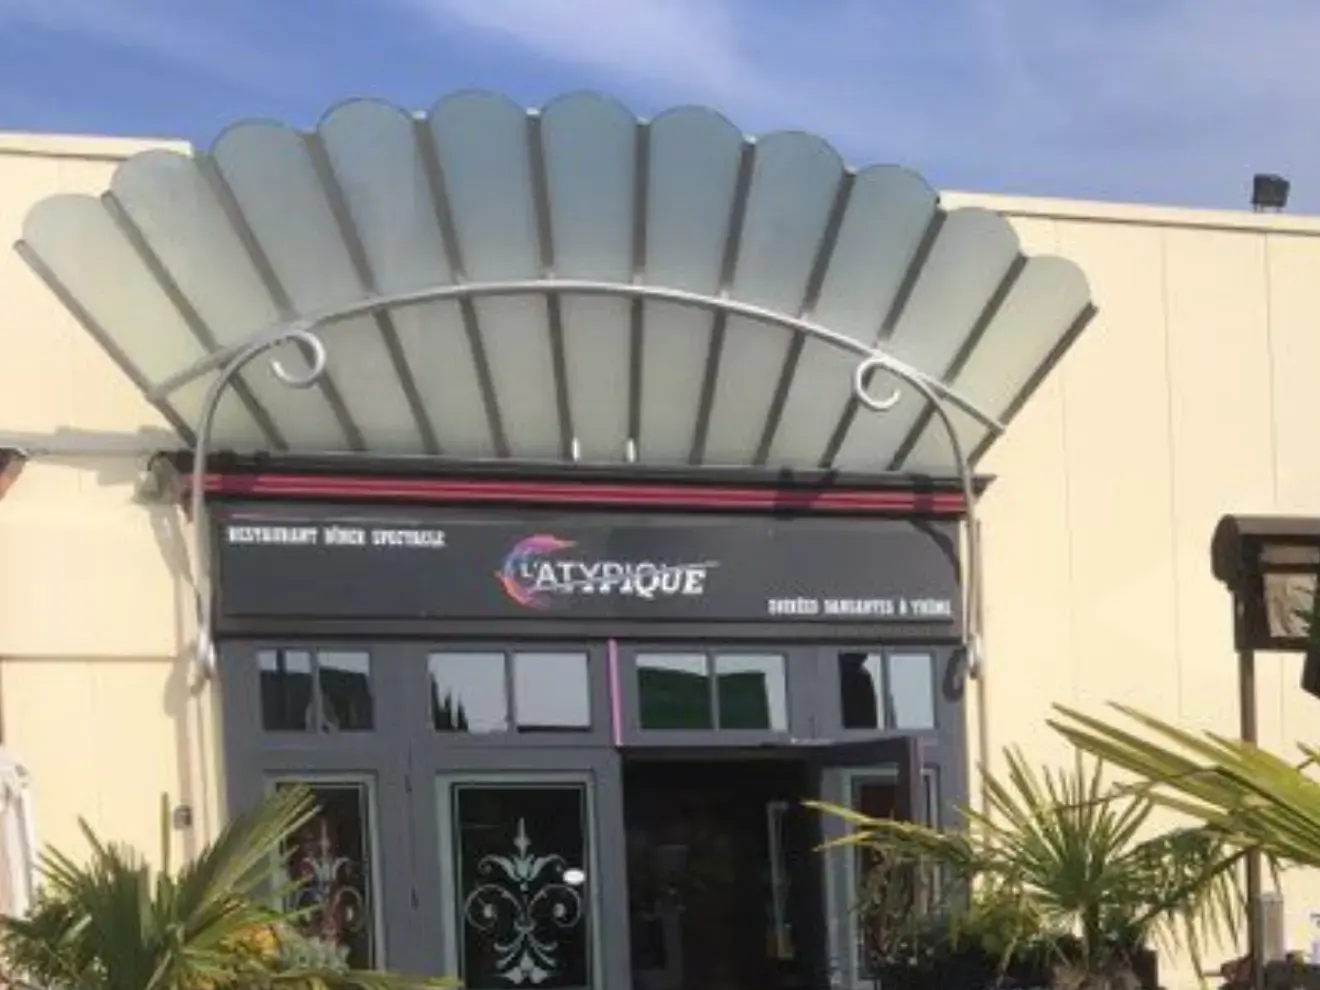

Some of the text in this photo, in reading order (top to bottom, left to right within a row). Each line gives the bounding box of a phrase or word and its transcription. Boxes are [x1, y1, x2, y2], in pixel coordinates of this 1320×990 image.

[228, 525, 318, 545] RESTAURANT
[371, 528, 446, 548] SPECTACLE
[519, 559, 710, 598] L'ATYPIQUE
